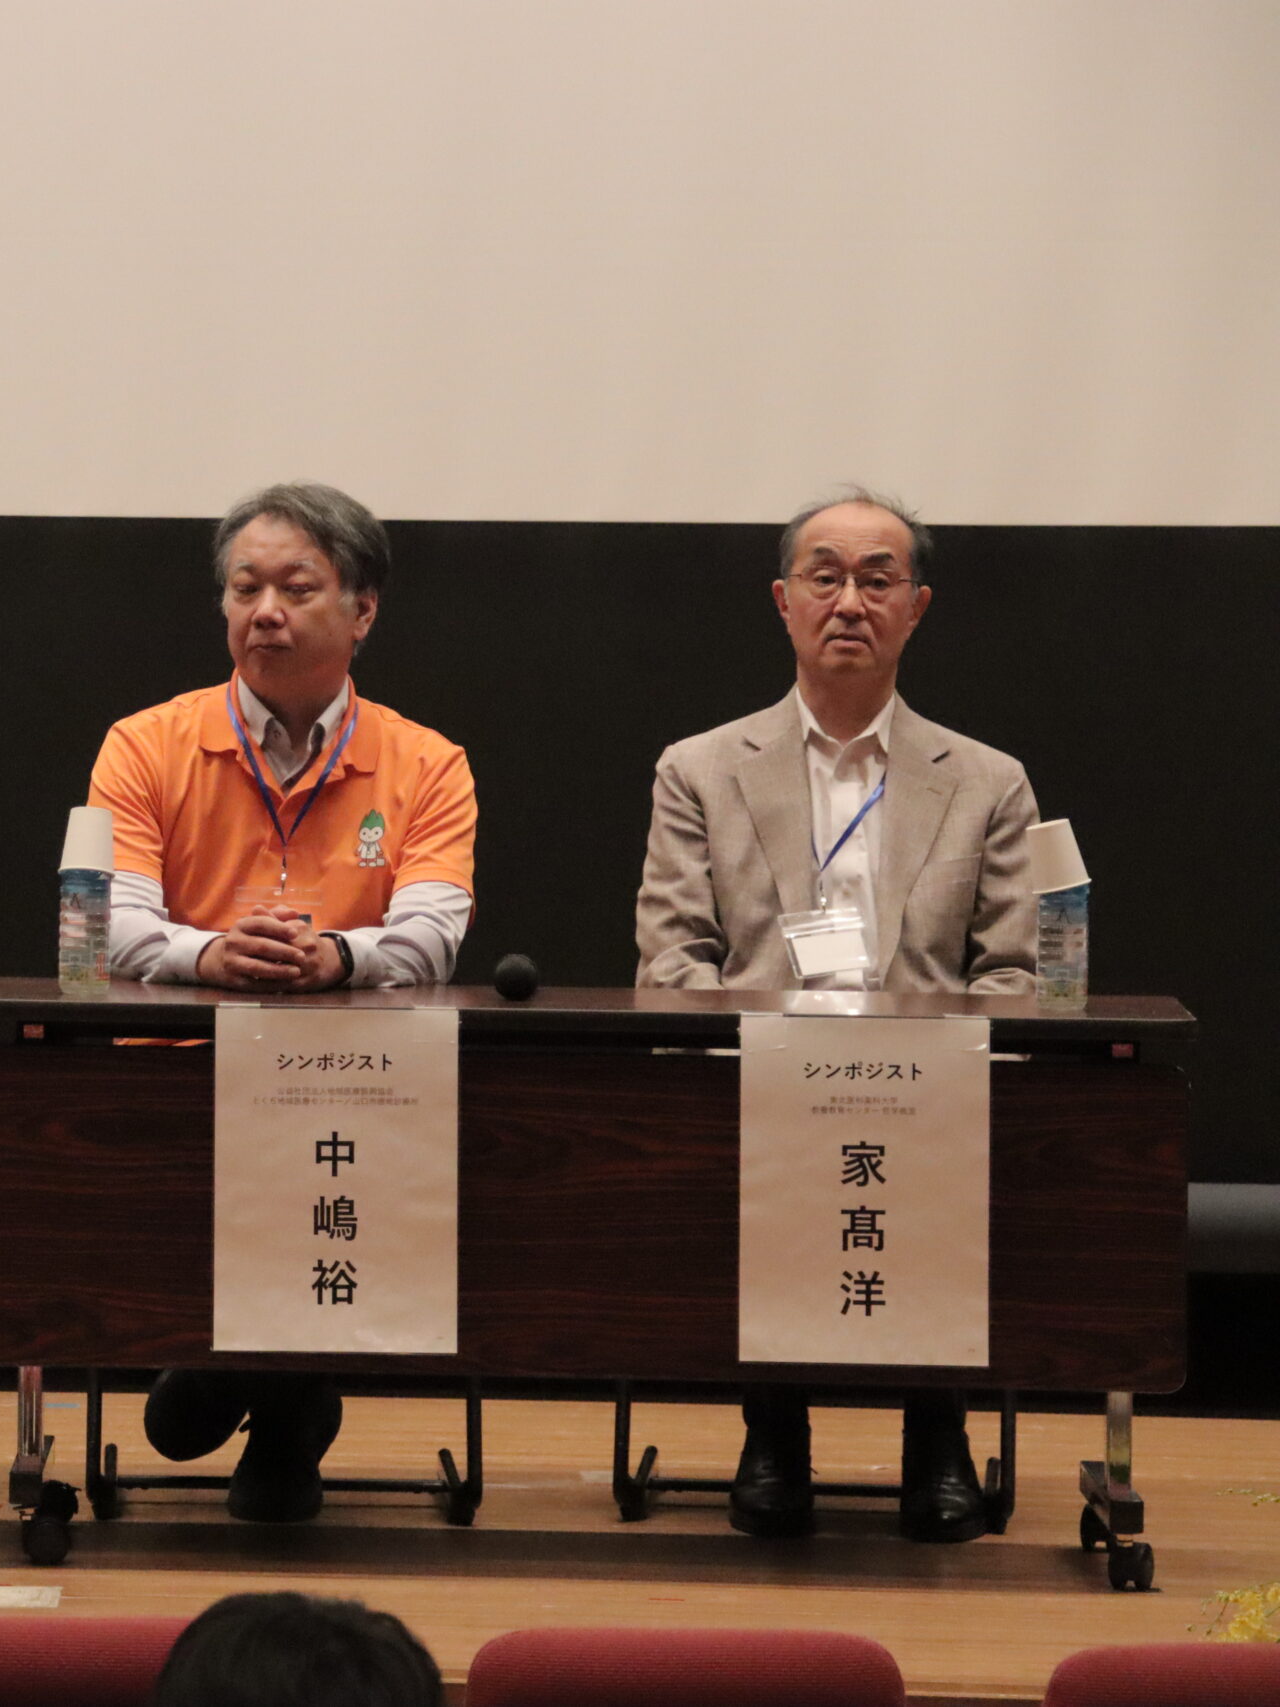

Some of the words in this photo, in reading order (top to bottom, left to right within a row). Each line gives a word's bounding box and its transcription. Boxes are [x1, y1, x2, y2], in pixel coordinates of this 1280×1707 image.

[277, 1053, 393, 1072] シンポジスト
[804, 1061, 922, 1081] シンポジスト
[311, 1131, 358, 1306] 中嶋裕
